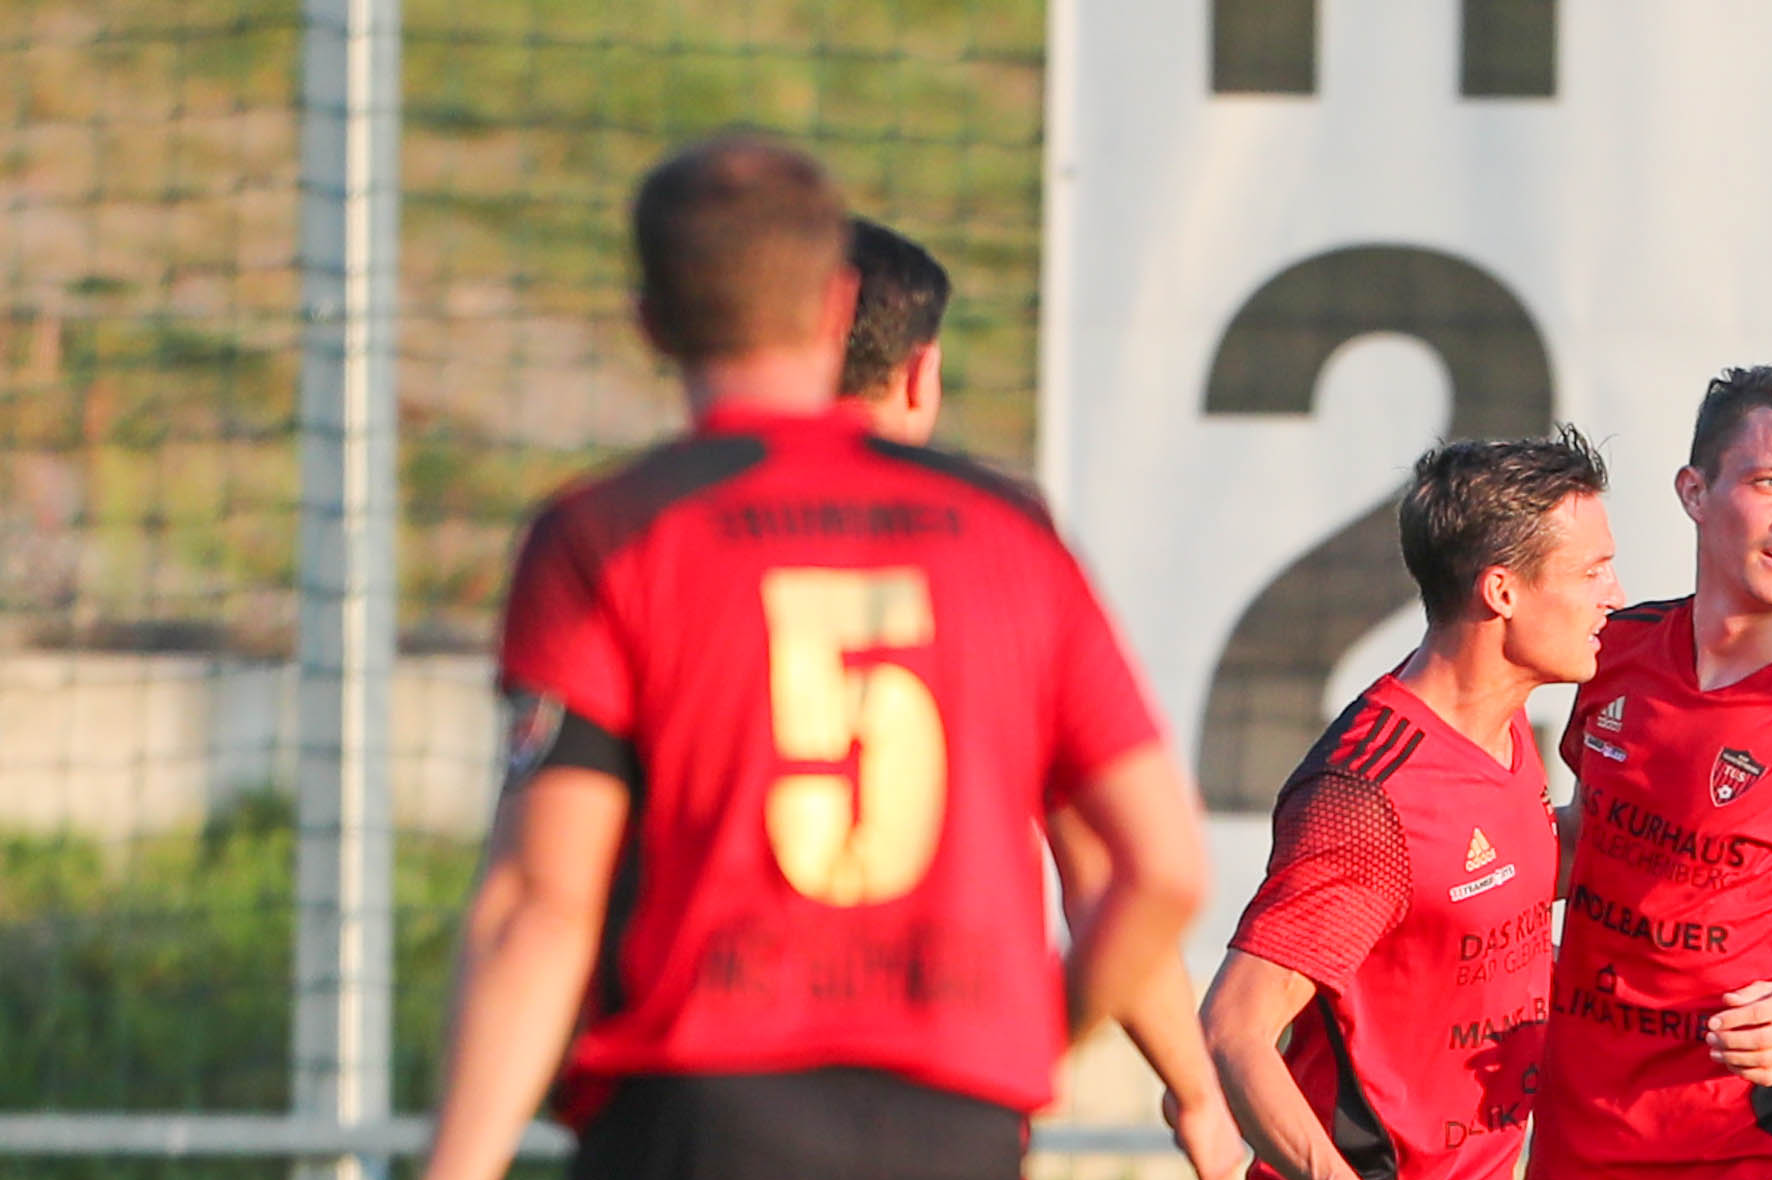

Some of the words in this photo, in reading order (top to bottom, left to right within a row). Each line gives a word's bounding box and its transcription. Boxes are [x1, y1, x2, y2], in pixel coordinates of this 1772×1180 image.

[1200, 243, 1560, 813] 2
[761, 567, 947, 907] 5
[1608, 797, 1744, 867] KURHAUS
[1460, 921, 1511, 962] DAS
